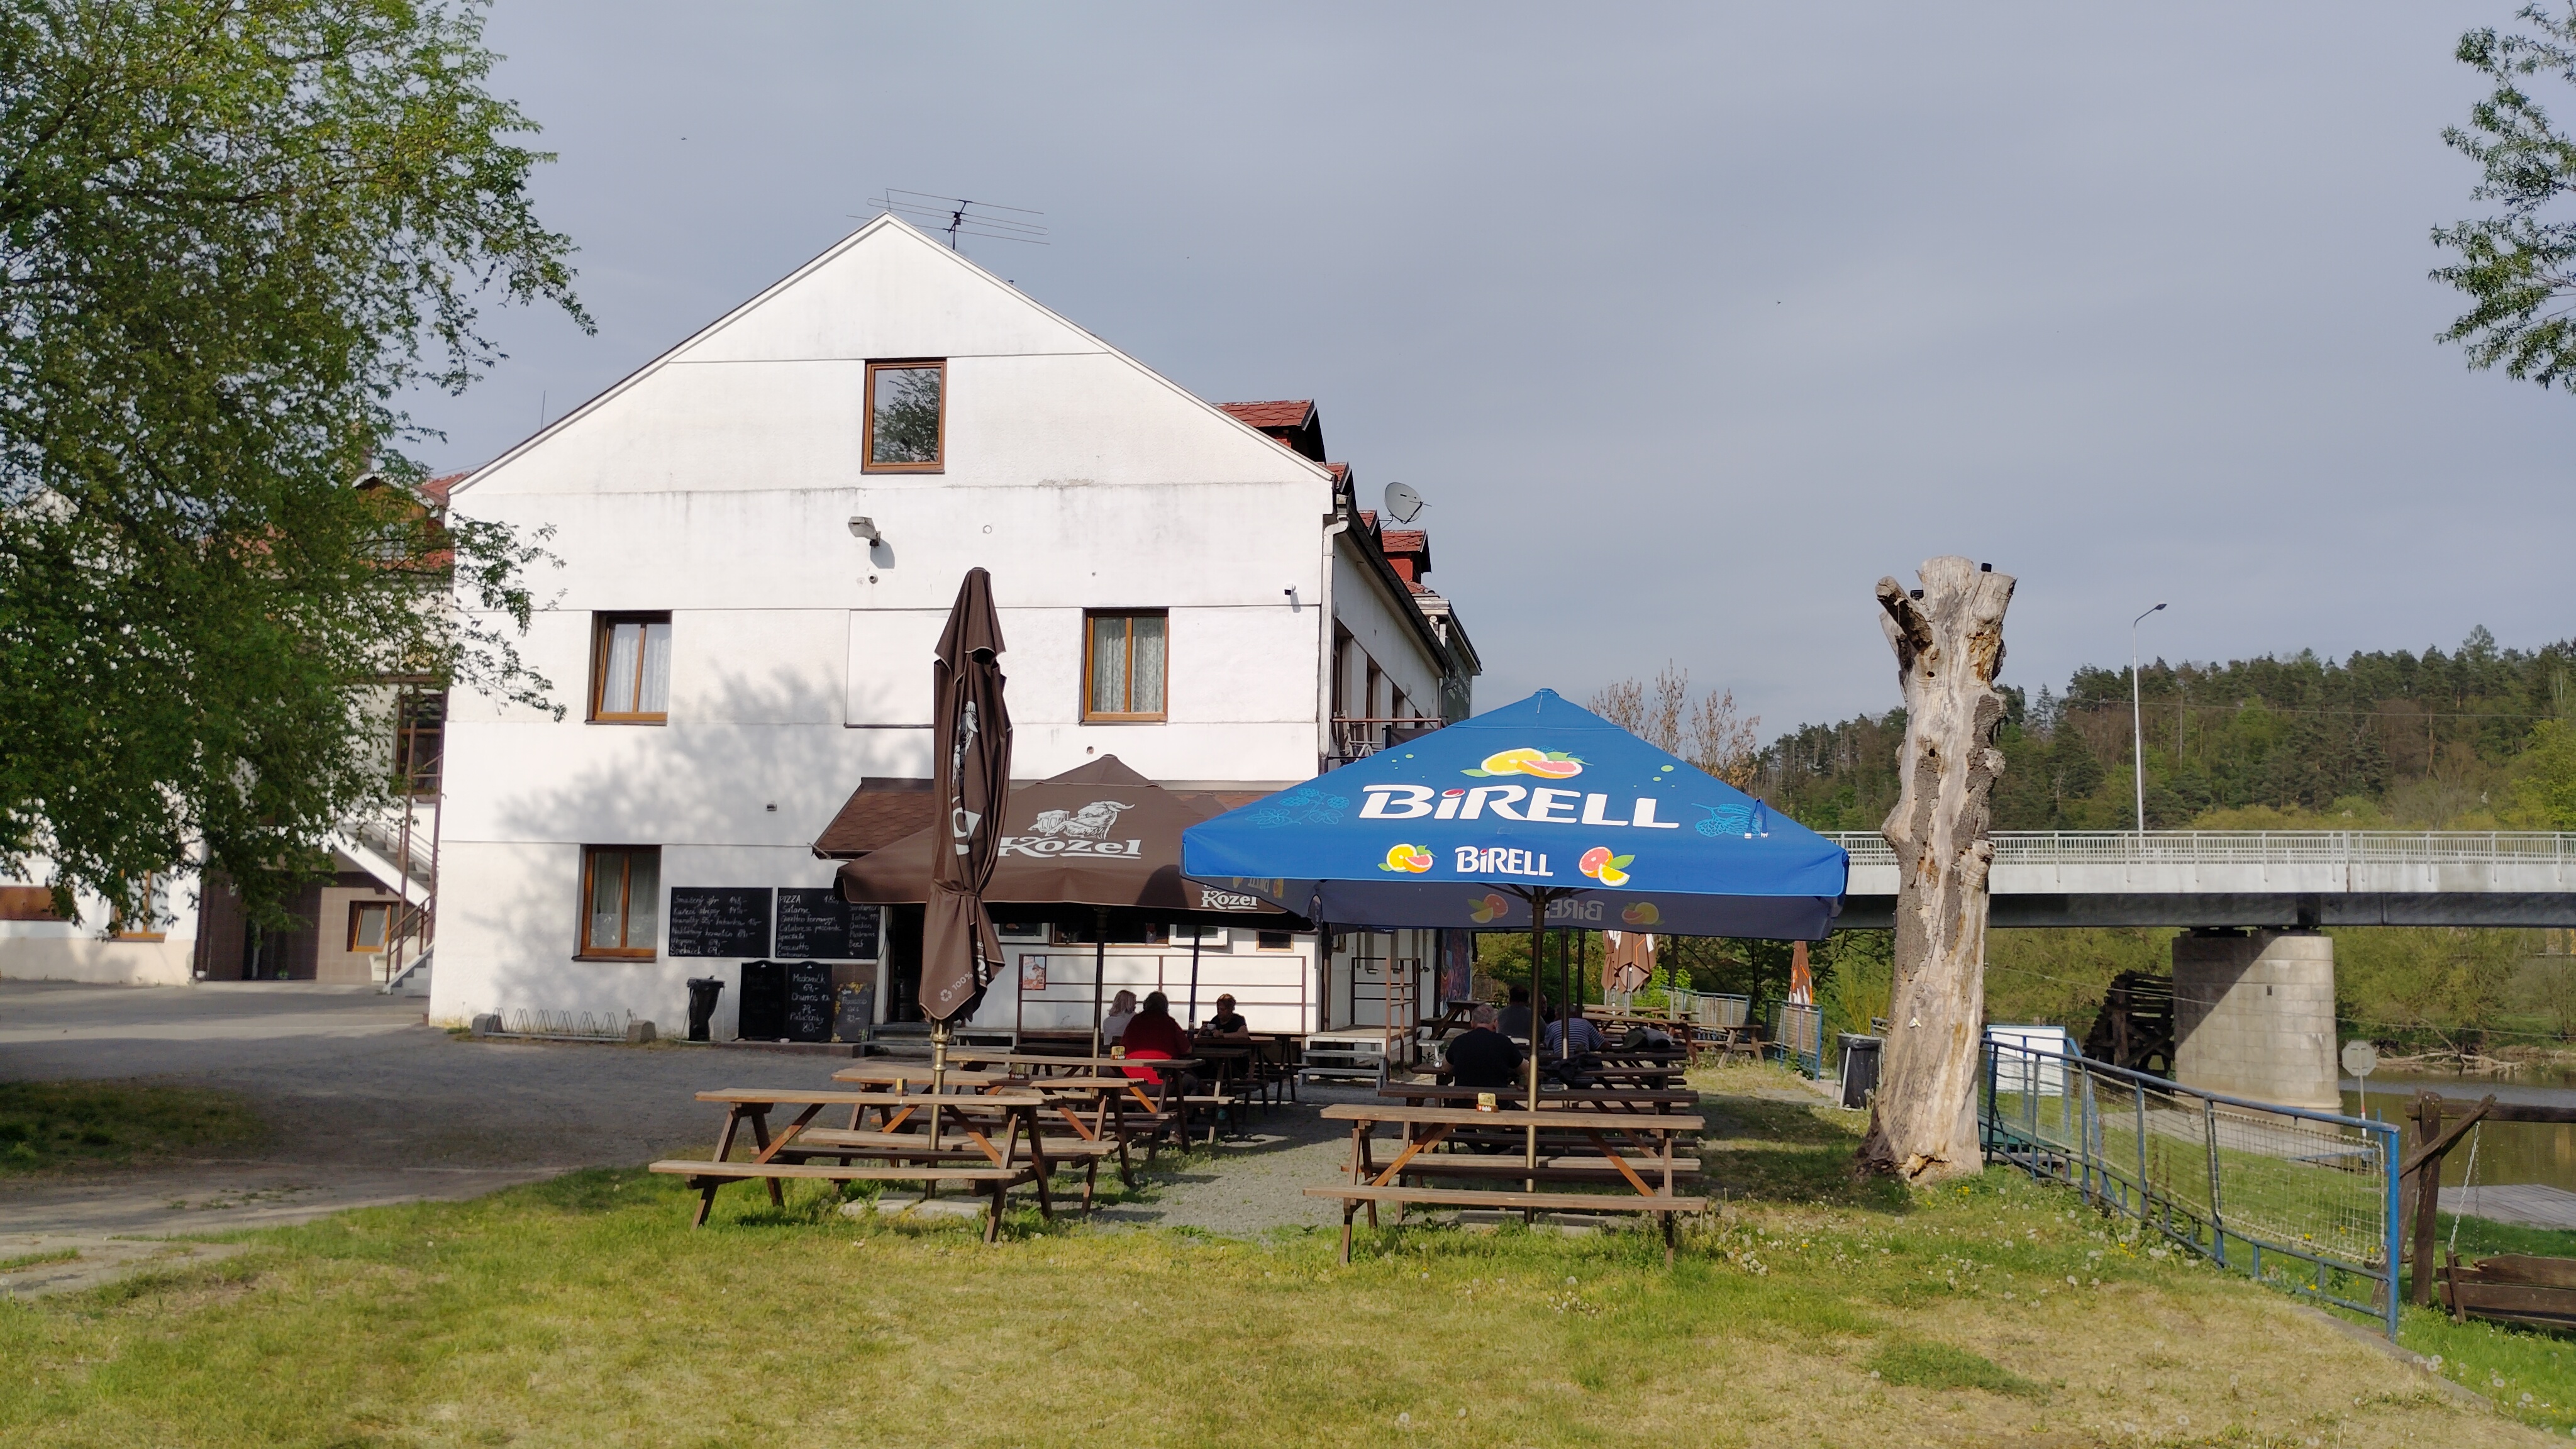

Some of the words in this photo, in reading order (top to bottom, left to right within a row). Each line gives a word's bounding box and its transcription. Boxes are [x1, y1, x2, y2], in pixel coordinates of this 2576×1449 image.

[998, 836, 1141, 858] Kozel
[779, 895, 801, 904] PIZZA
[1201, 890, 1258, 910] Kozel
[952, 971, 973, 991] 100%
